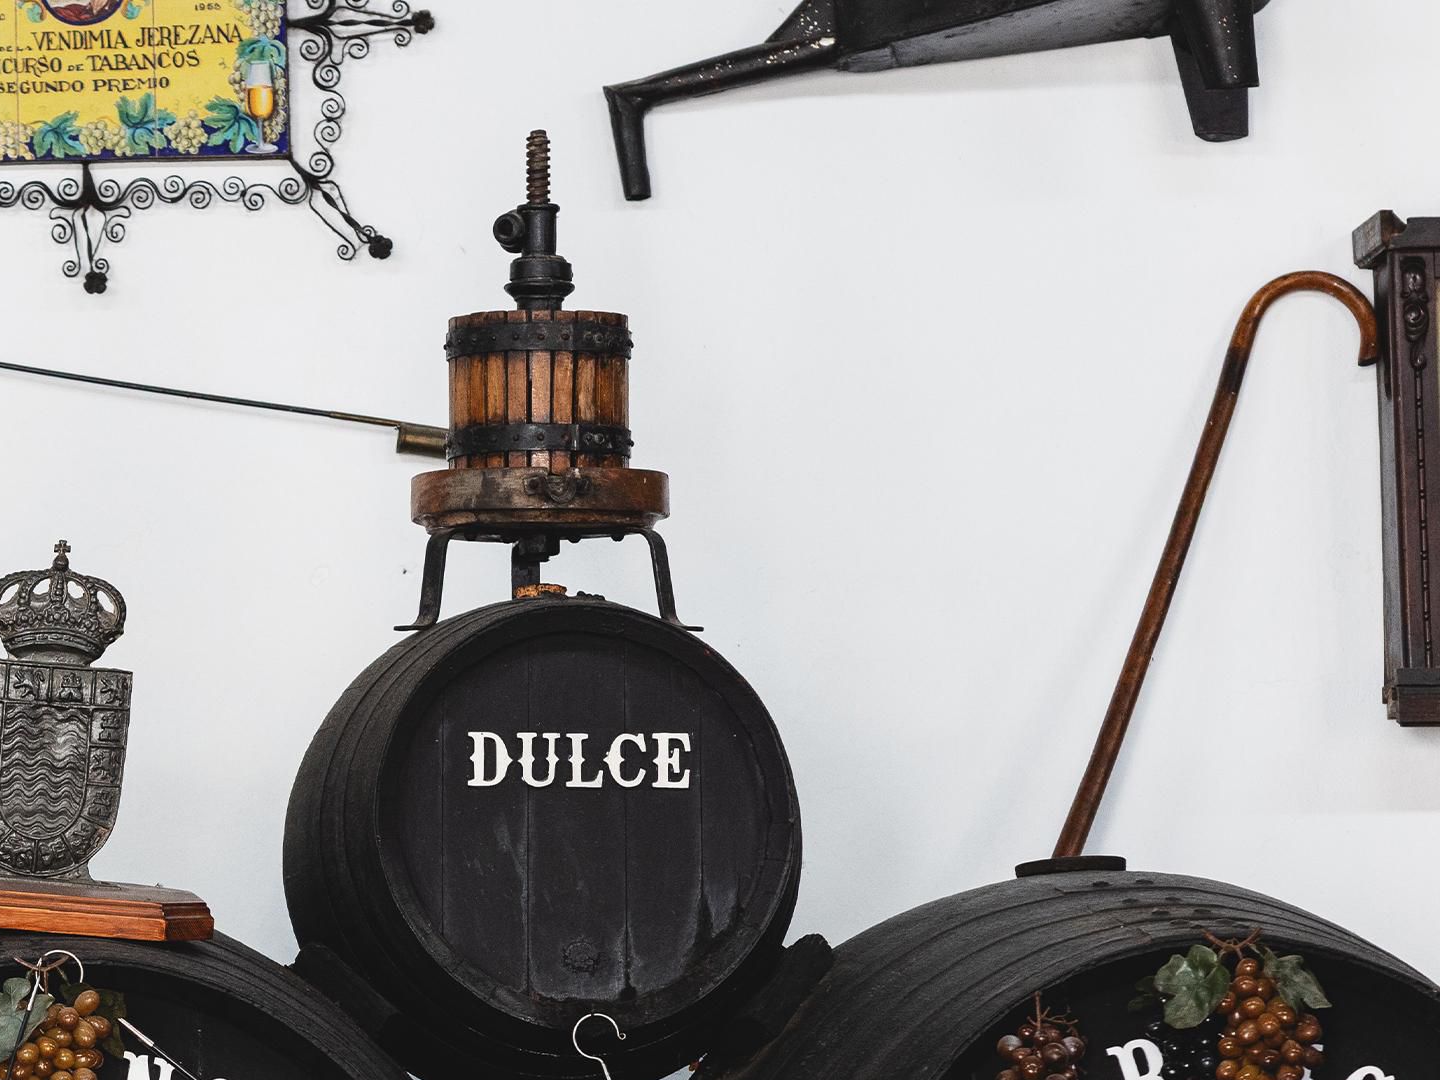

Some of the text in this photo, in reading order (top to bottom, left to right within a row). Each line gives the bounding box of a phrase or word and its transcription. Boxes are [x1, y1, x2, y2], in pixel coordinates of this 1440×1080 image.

[32, 29, 131, 51] VENDIMIA
[135, 23, 243, 49] JEREZANA
[67, 63, 84, 72] DE
[86, 50, 200, 72] TABANCOS
[93, 76, 170, 92] PREMIO
[467, 731, 691, 789] DULCE
